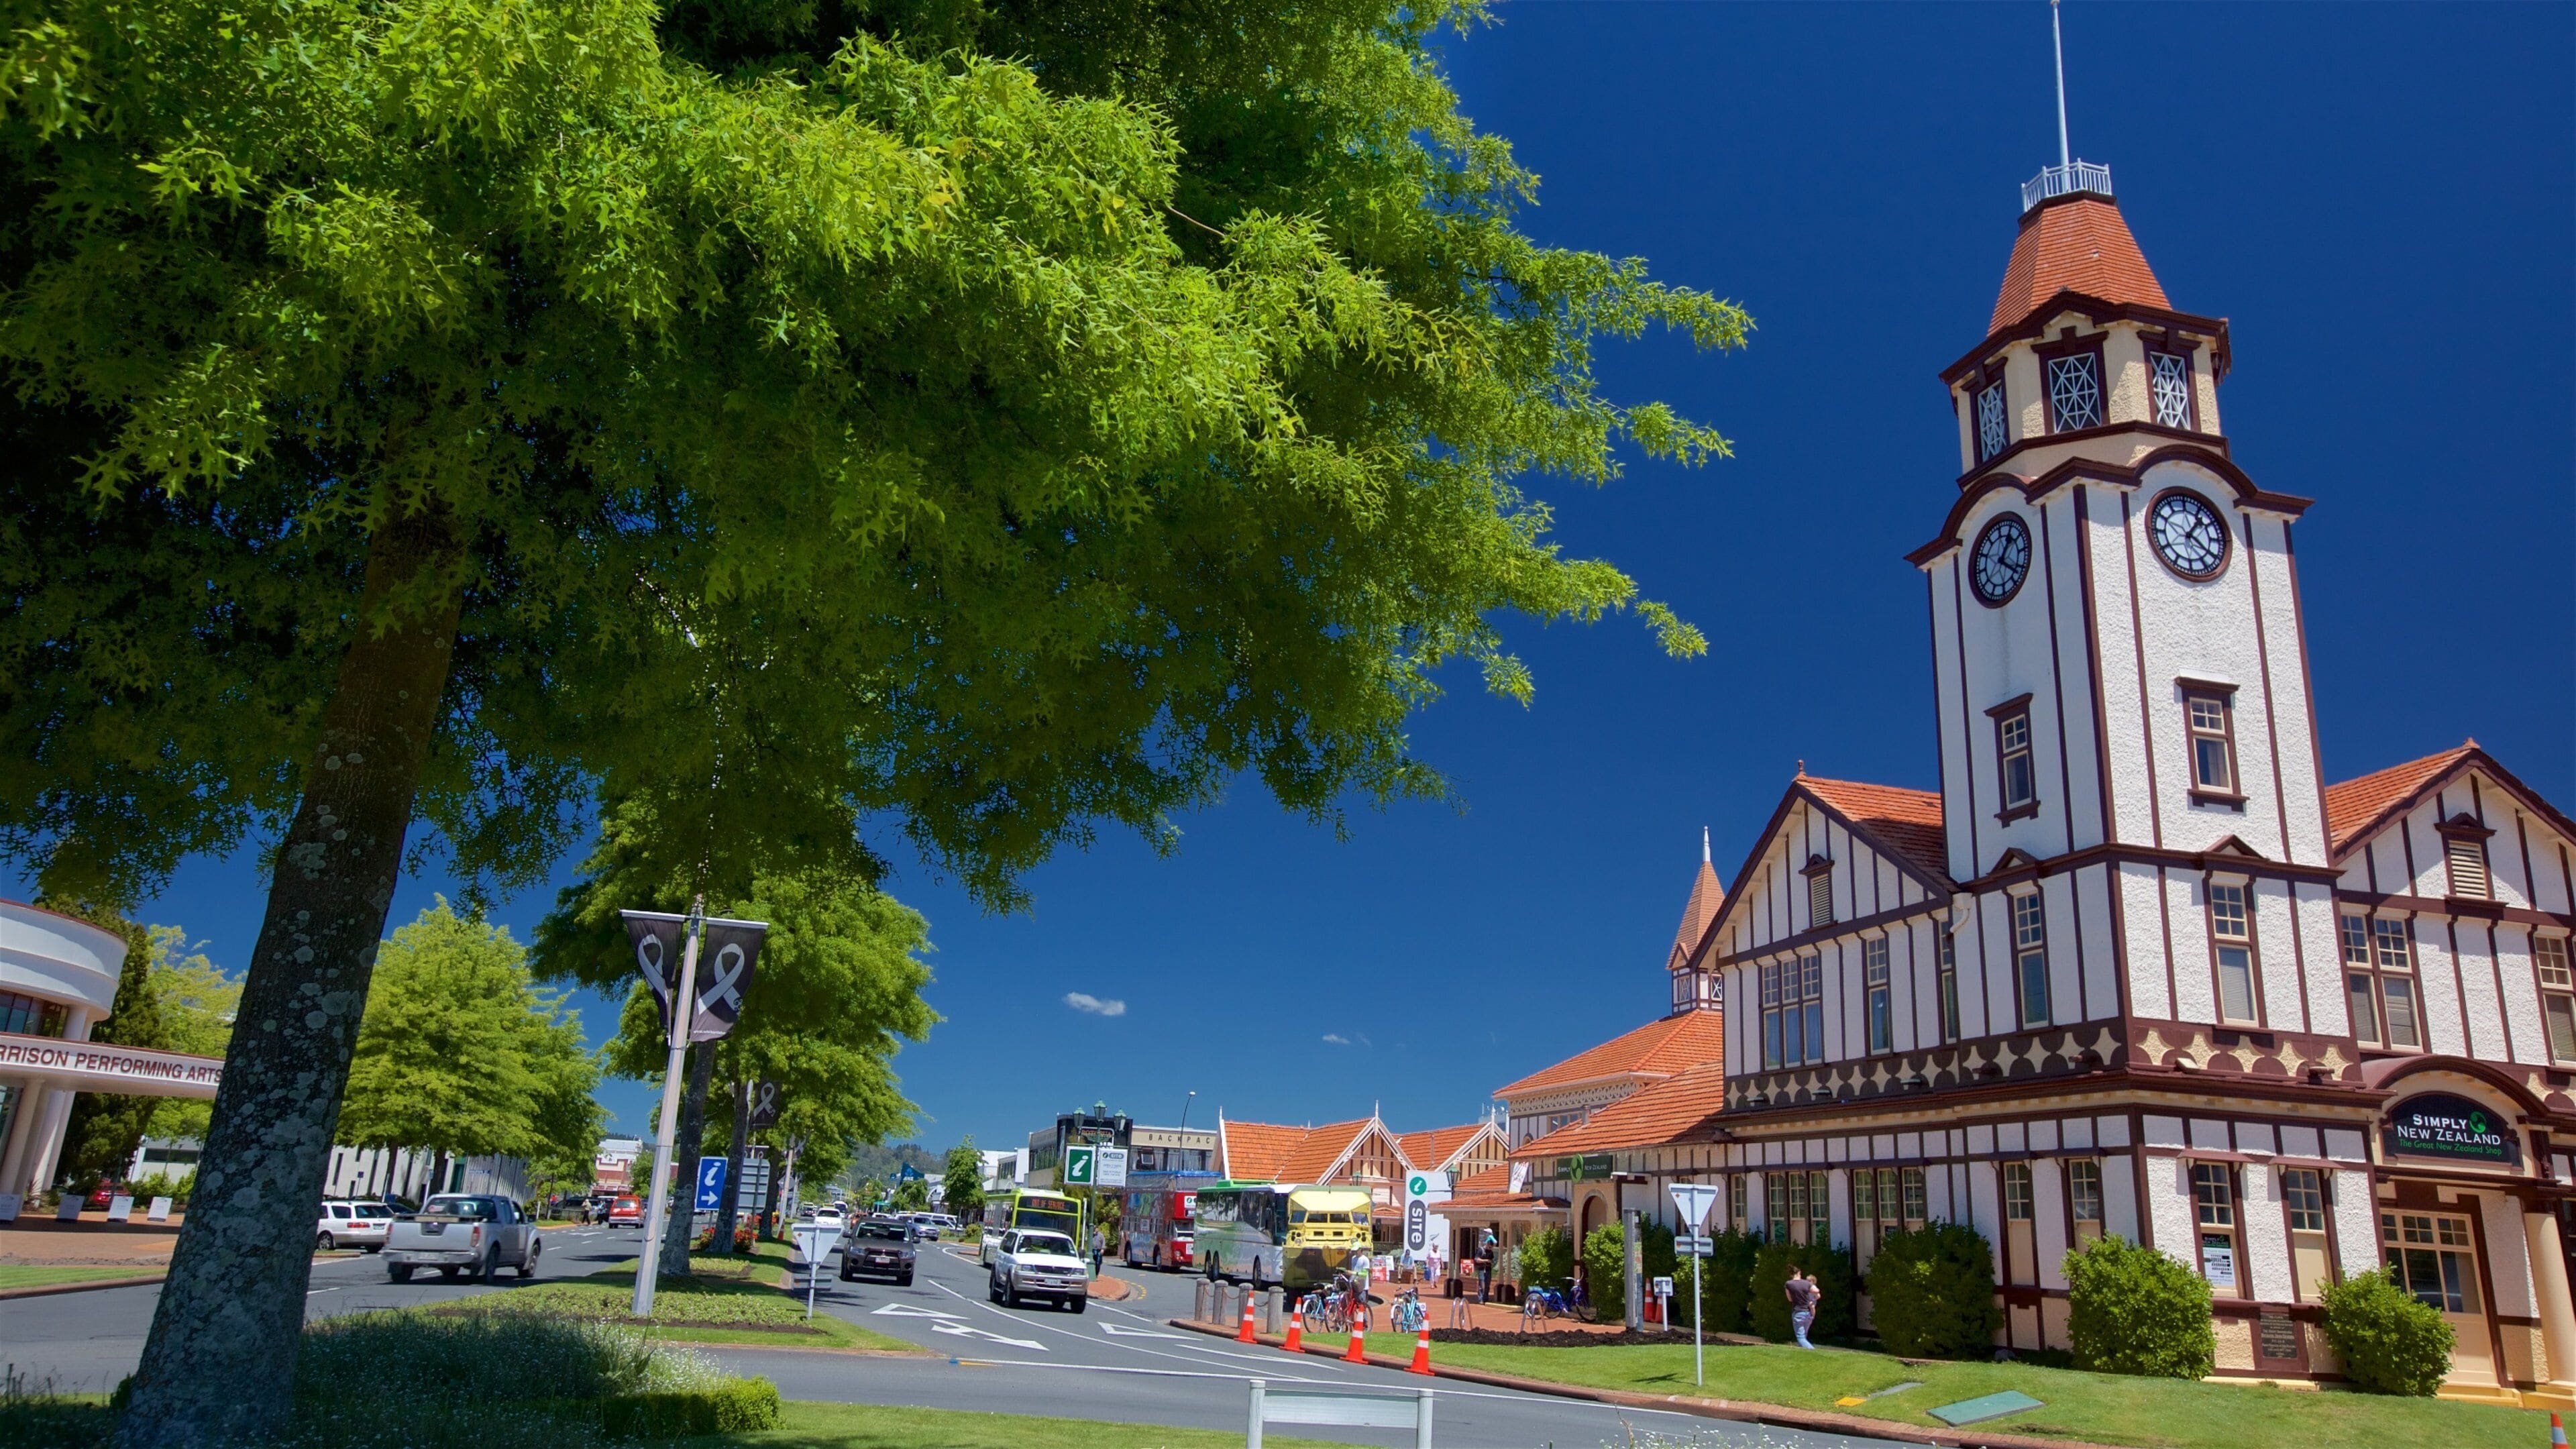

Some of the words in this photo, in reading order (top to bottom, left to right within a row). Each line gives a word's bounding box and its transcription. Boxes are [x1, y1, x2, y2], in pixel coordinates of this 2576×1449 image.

[75, 1053, 183, 1079] PERFORMING
[186, 1066, 223, 1082] ARTS
[2413, 1114, 2467, 1130] SIMPLY
[2397, 1126, 2430, 1139] NEW
[2435, 1129, 2501, 1145] ZEALAND
[2399, 1139, 2412, 1148] The
[2414, 1141, 2434, 1149] Great
[2436, 1142, 2452, 1150] New
[2455, 1144, 2483, 1153] Zealand
[2485, 1146, 2502, 1156] Shop
[1031, 1199, 1040, 1207] OUT
[1048, 1200, 1065, 1209] SERVICE
